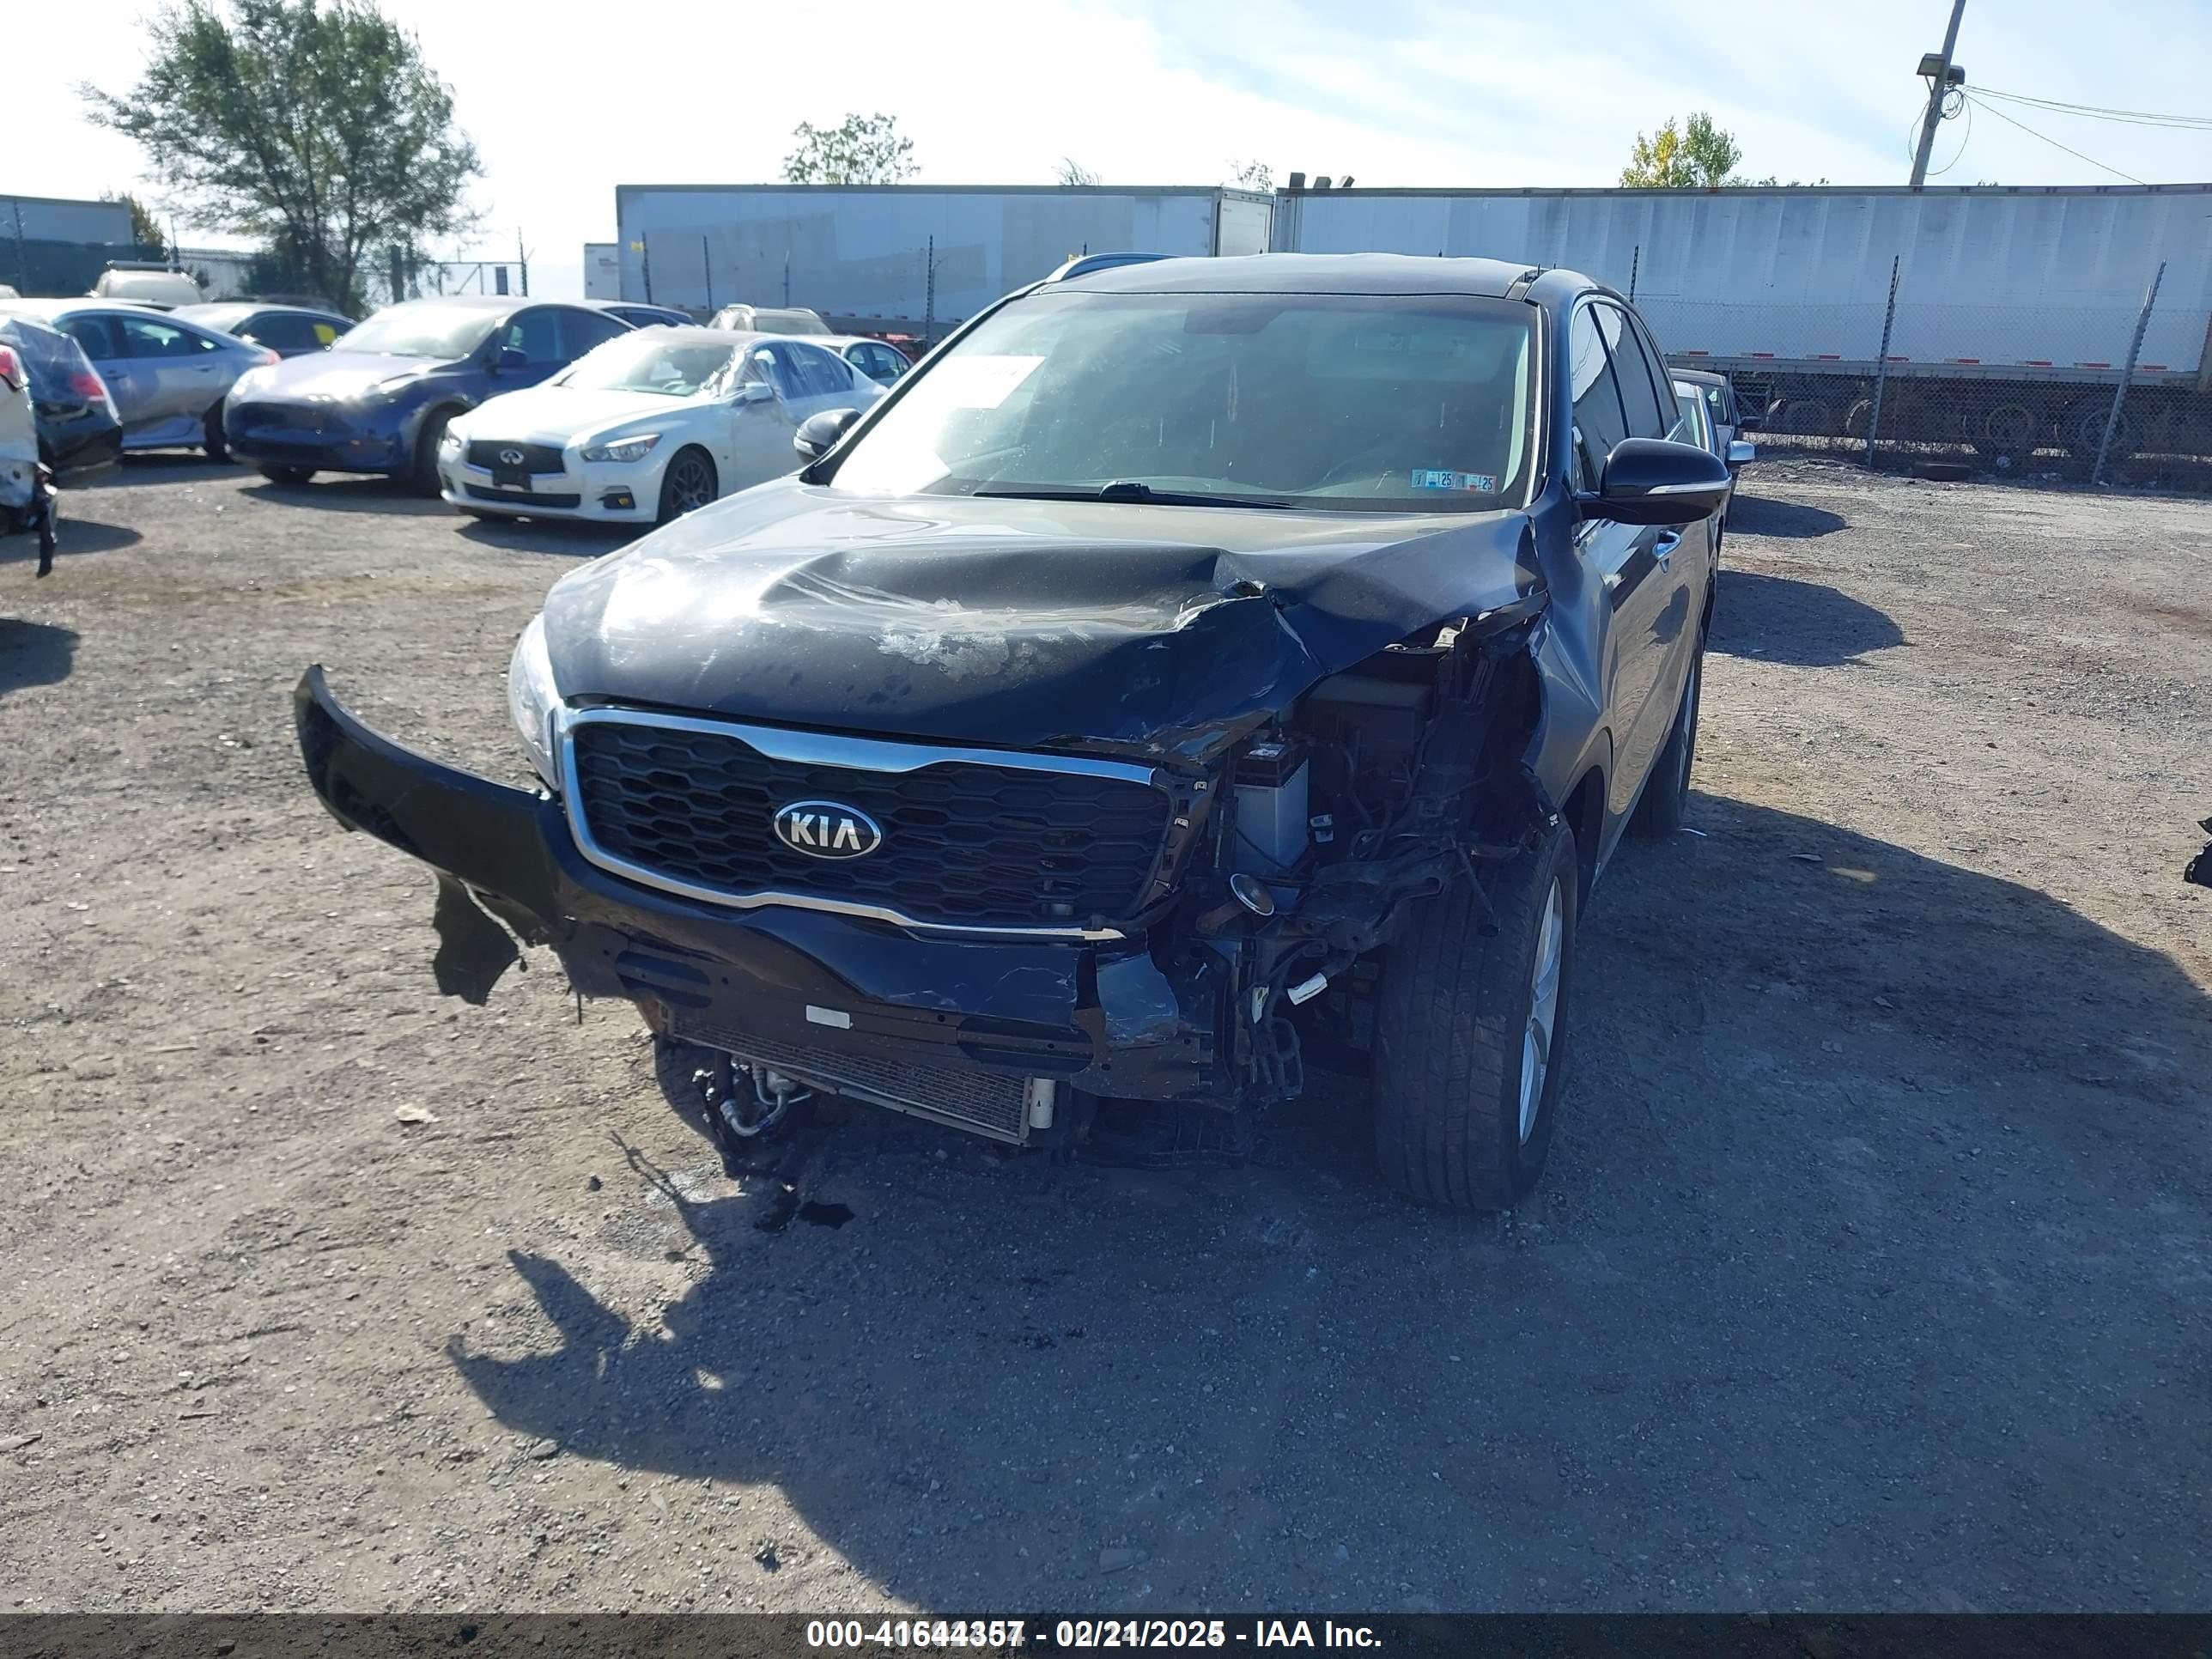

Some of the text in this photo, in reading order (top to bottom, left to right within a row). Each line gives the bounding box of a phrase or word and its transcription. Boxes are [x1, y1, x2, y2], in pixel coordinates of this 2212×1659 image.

[1442, 473, 1452, 486] 25
[1482, 477, 1493, 490] 25
[790, 811, 862, 850] KIA
